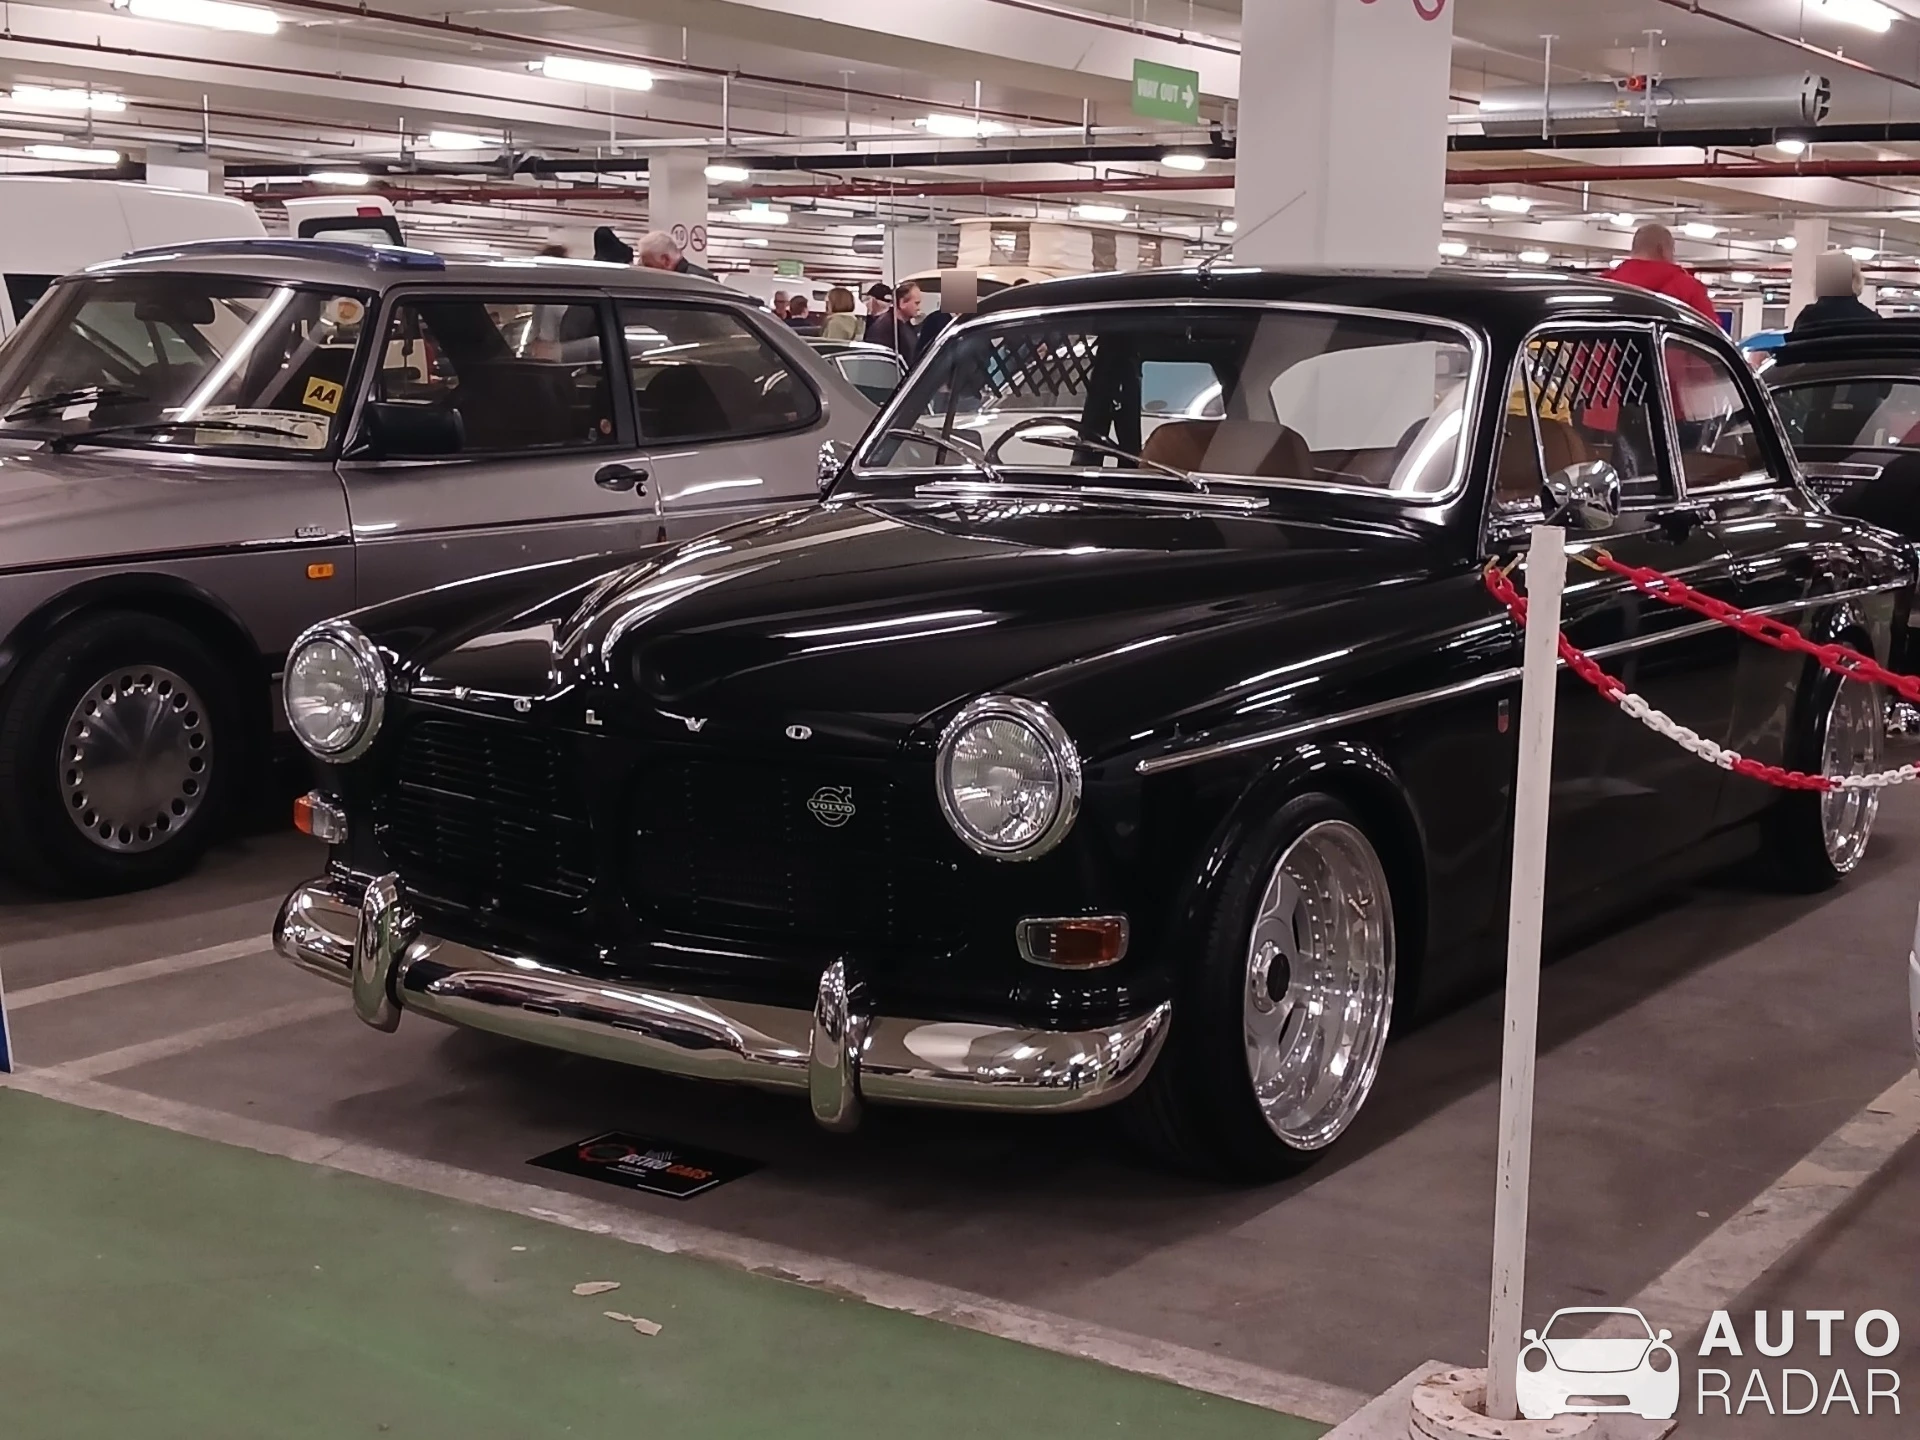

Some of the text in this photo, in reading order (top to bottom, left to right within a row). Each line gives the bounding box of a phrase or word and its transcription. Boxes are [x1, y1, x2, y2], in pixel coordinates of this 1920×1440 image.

[308, 385, 337, 404] AA
[810, 801, 853, 813] VOLVO
[666, 1164, 713, 1180] CARS
